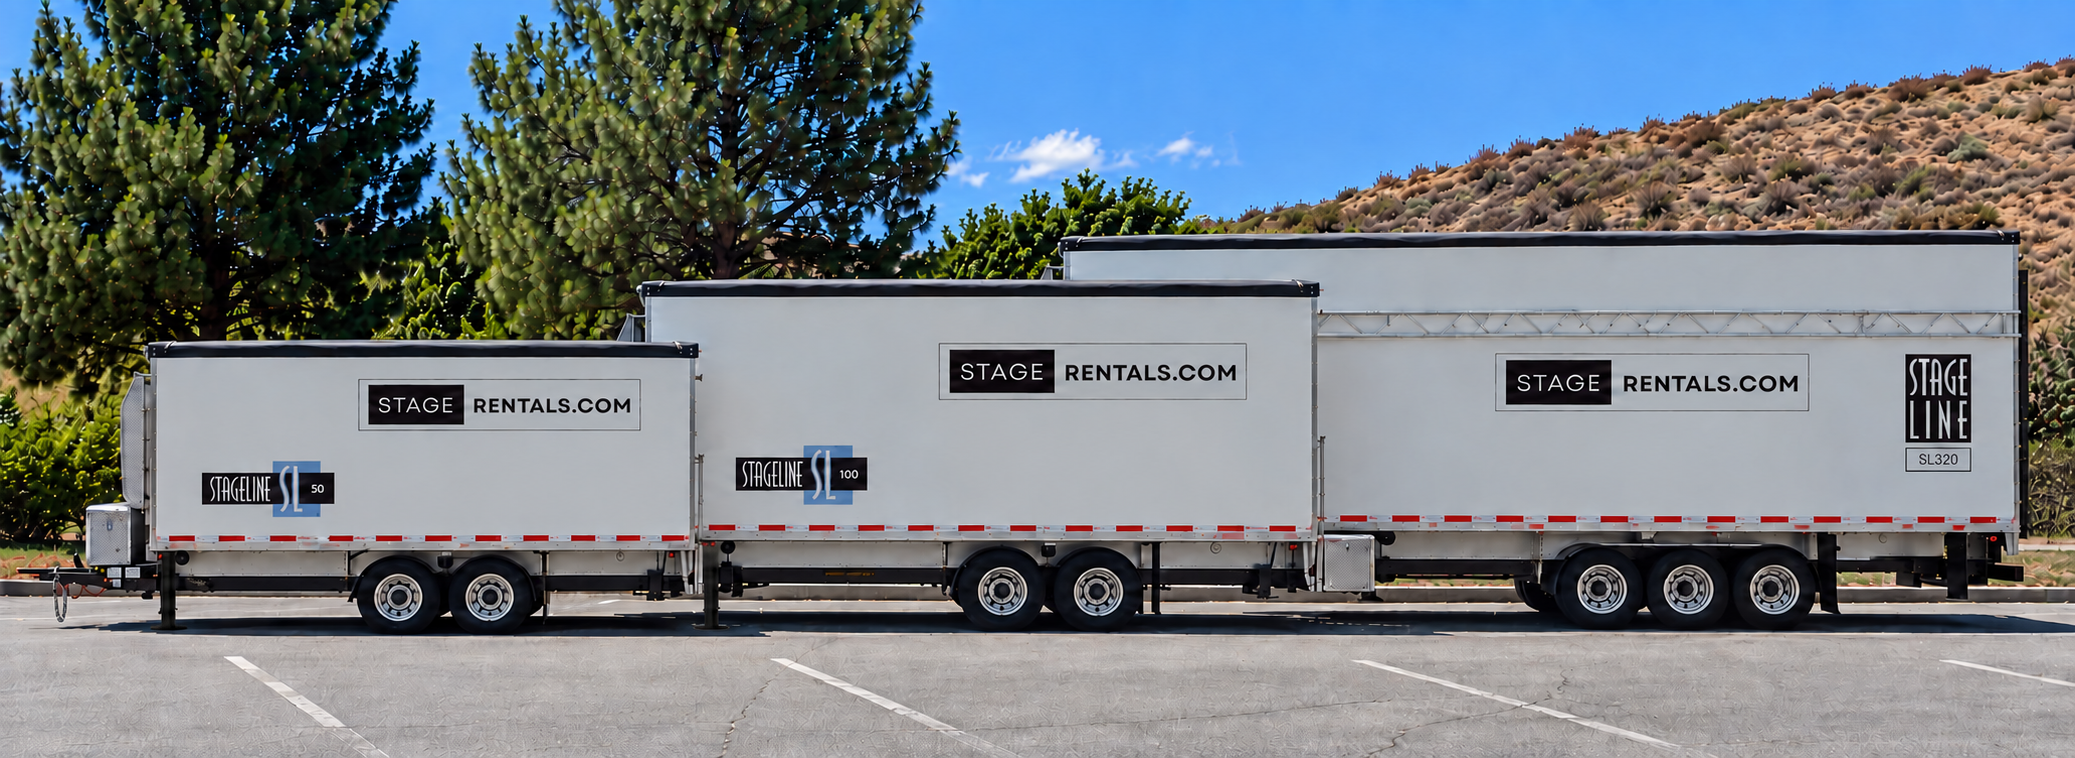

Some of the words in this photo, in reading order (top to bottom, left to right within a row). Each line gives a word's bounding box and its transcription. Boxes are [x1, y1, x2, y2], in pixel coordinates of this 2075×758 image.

[960, 362, 1044, 381] STAGE
[1065, 364, 1237, 382] RENTALS.COM
[1517, 374, 1600, 392] STAGE
[1623, 374, 1799, 393] RENTALS.COM
[1909, 358, 1968, 396] STAGE
[378, 397, 453, 414] STAGE
[473, 397, 631, 414] RENTALS.COM
[1909, 401, 1968, 440] LINE
[1918, 453, 1959, 466] SL320
[209, 475, 271, 502] STAGELINE
[279, 465, 303, 513] SL
[311, 484, 325, 494] 50
[742, 460, 804, 488] STAGELINE
[811, 449, 836, 500] SL
[839, 469, 859, 480] 100
